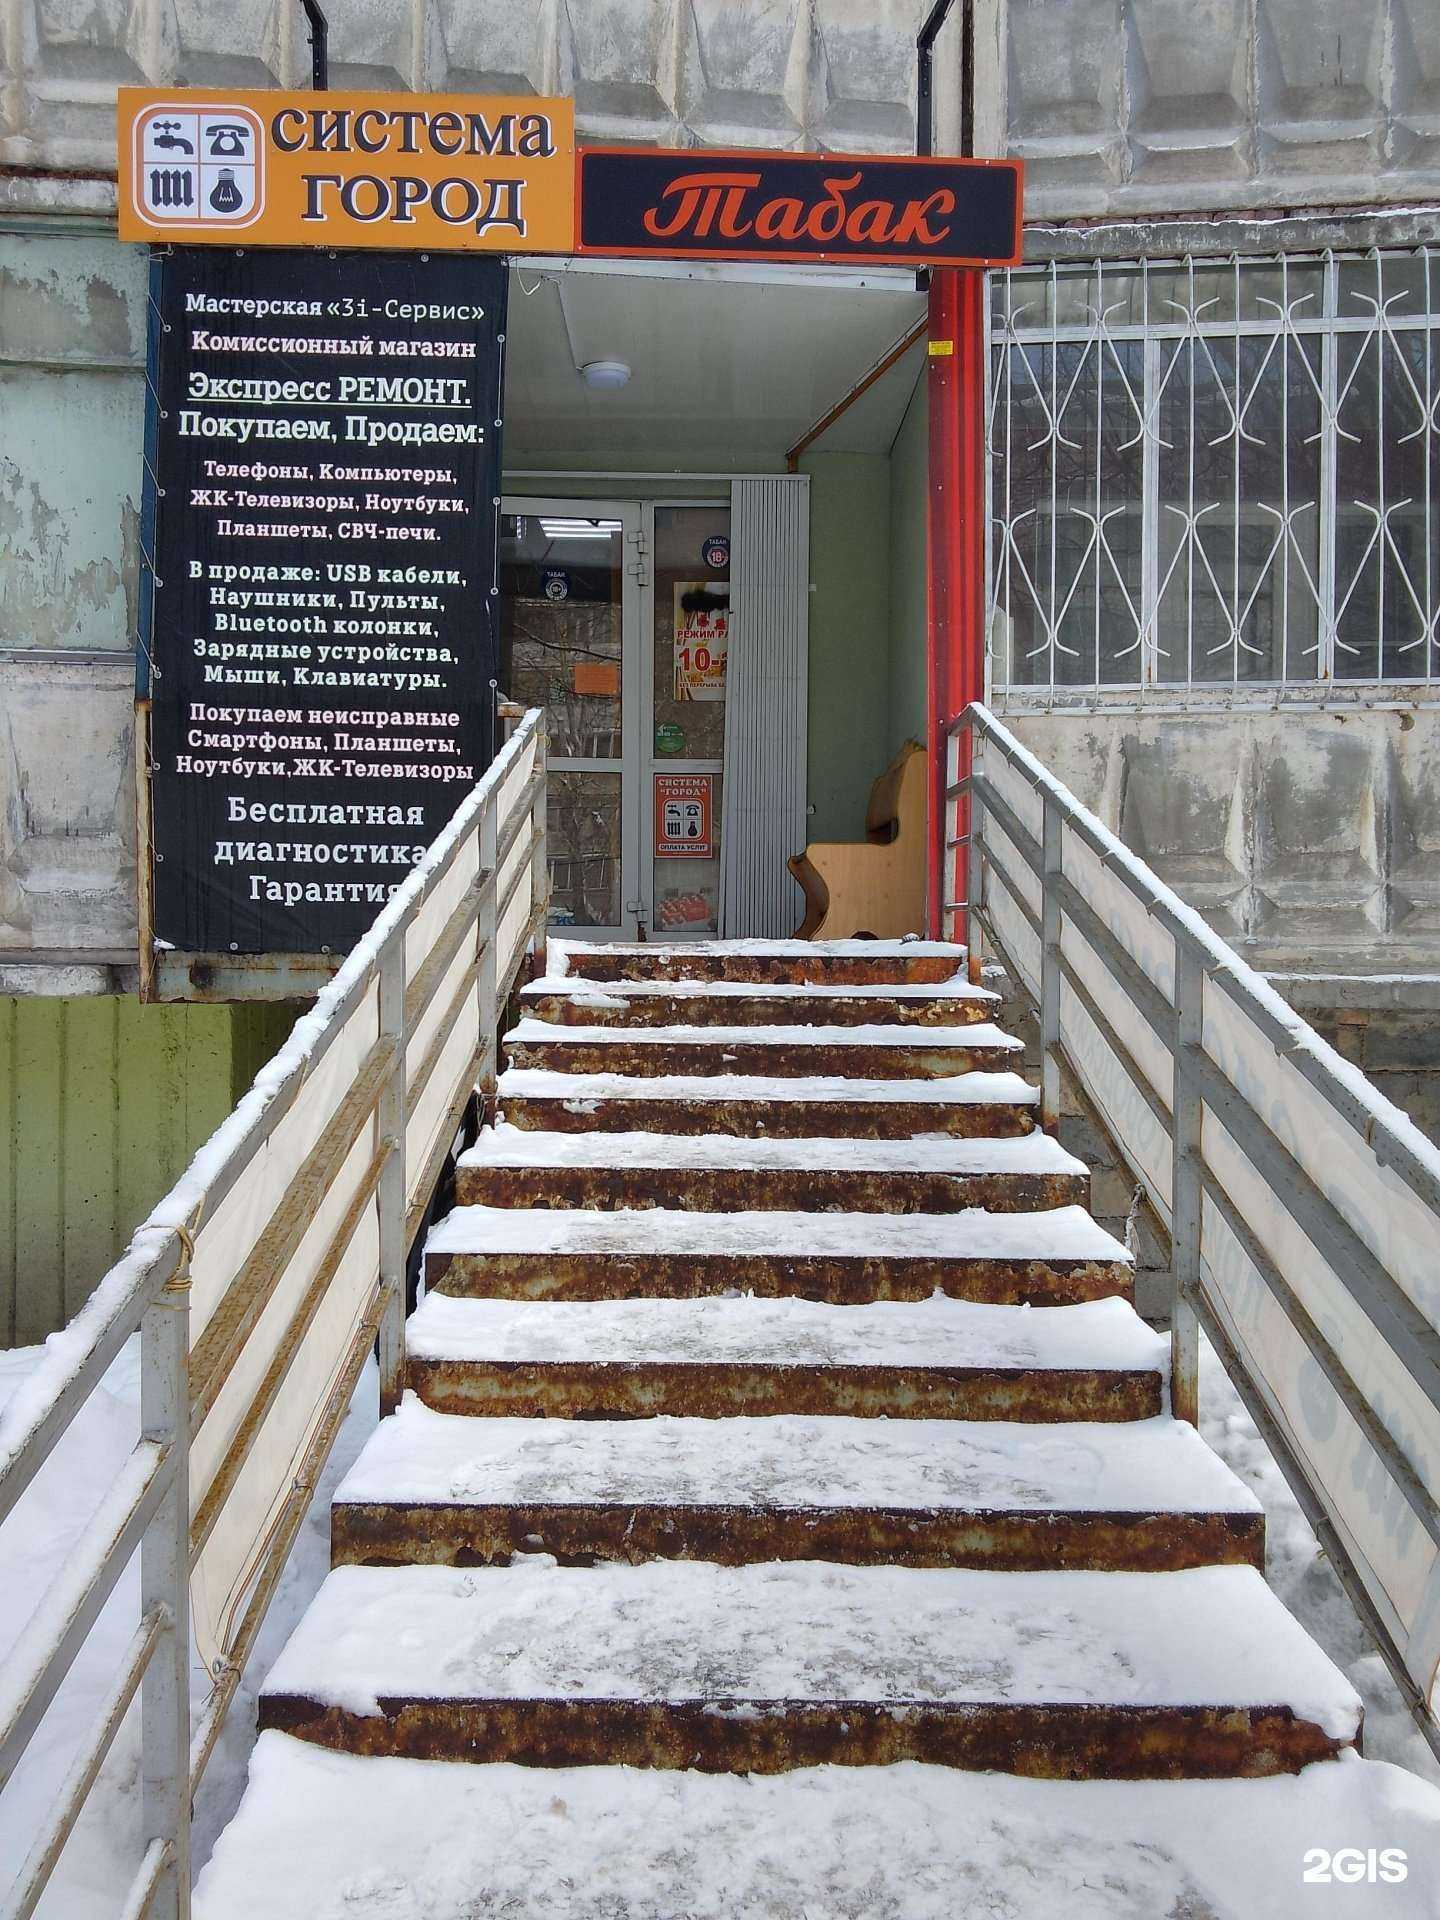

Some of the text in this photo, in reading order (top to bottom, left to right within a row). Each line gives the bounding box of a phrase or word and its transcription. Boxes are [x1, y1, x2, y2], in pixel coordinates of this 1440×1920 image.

[300, 174, 528, 236] ГОРОД
[643, 171, 956, 245] Табак
[185, 293, 485, 323] Мастерская «3i-Сервис»
[191, 330, 477, 358] Комиссионный магазин
[188, 371, 471, 405] Экспресс РЕМОНТ.
[178, 410, 485, 447] Покупаем, Продаем:
[203, 460, 457, 486] Телефоны, Компьютеры,
[189, 489, 469, 515] ЖК-Телевизоры, Ноутбуки,
[217, 519, 441, 541] Планшеты, СВЧ-печи.
[188, 560, 467, 588] В продаже: USB кабели,
[209, 586, 445, 613] Наушники, Пульты,
[214, 613, 439, 639] Bluetooth колонки,
[677, 630, 715, 638] РЕЖИМ
[193, 638, 459, 665] Зарядные устройства,
[203, 664, 447, 691] Мыши, Клавиатуры.
[189, 702, 460, 729] Покупаем неисправные
[187, 729, 461, 756] Смартфоны, Планшеты,
[658, 778, 708, 786] СИСТЕМА
[227, 796, 425, 826] Бесплатная
[214, 842, 426, 865] диагностика
